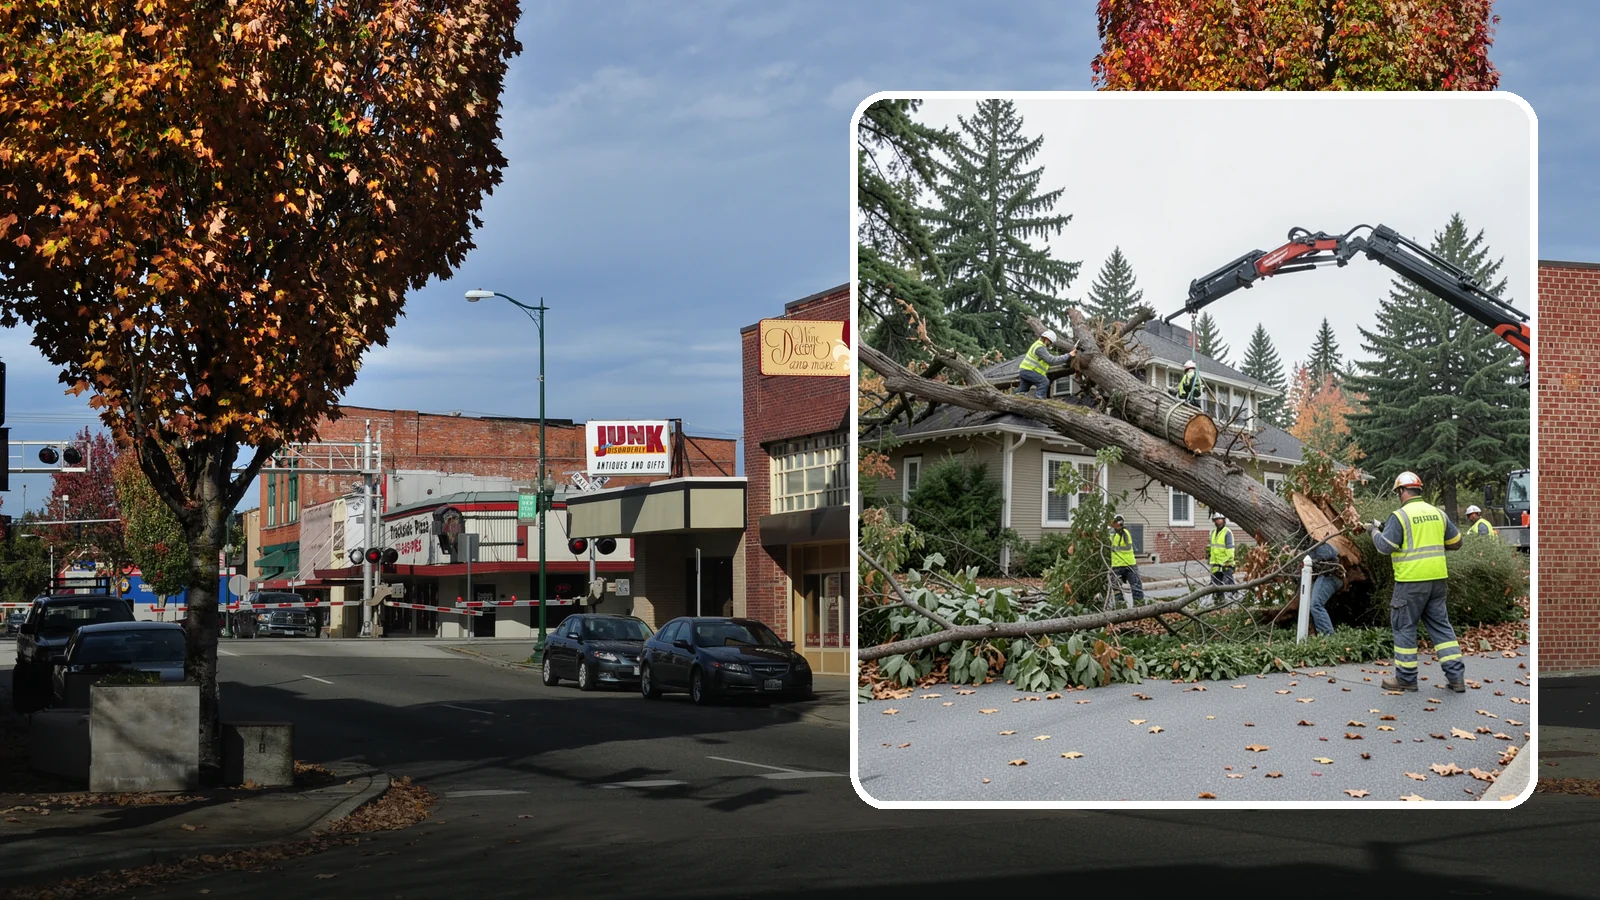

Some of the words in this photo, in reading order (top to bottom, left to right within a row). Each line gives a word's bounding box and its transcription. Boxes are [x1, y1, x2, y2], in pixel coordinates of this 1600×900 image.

[595, 425, 665, 457] JUNK
[607, 446, 646, 454] DISORDERLY
[597, 461, 628, 470] ANTIQUES
[631, 461, 644, 470] AND
[647, 460, 665, 470] GIFTS
[414, 519, 429, 535] Pizza
